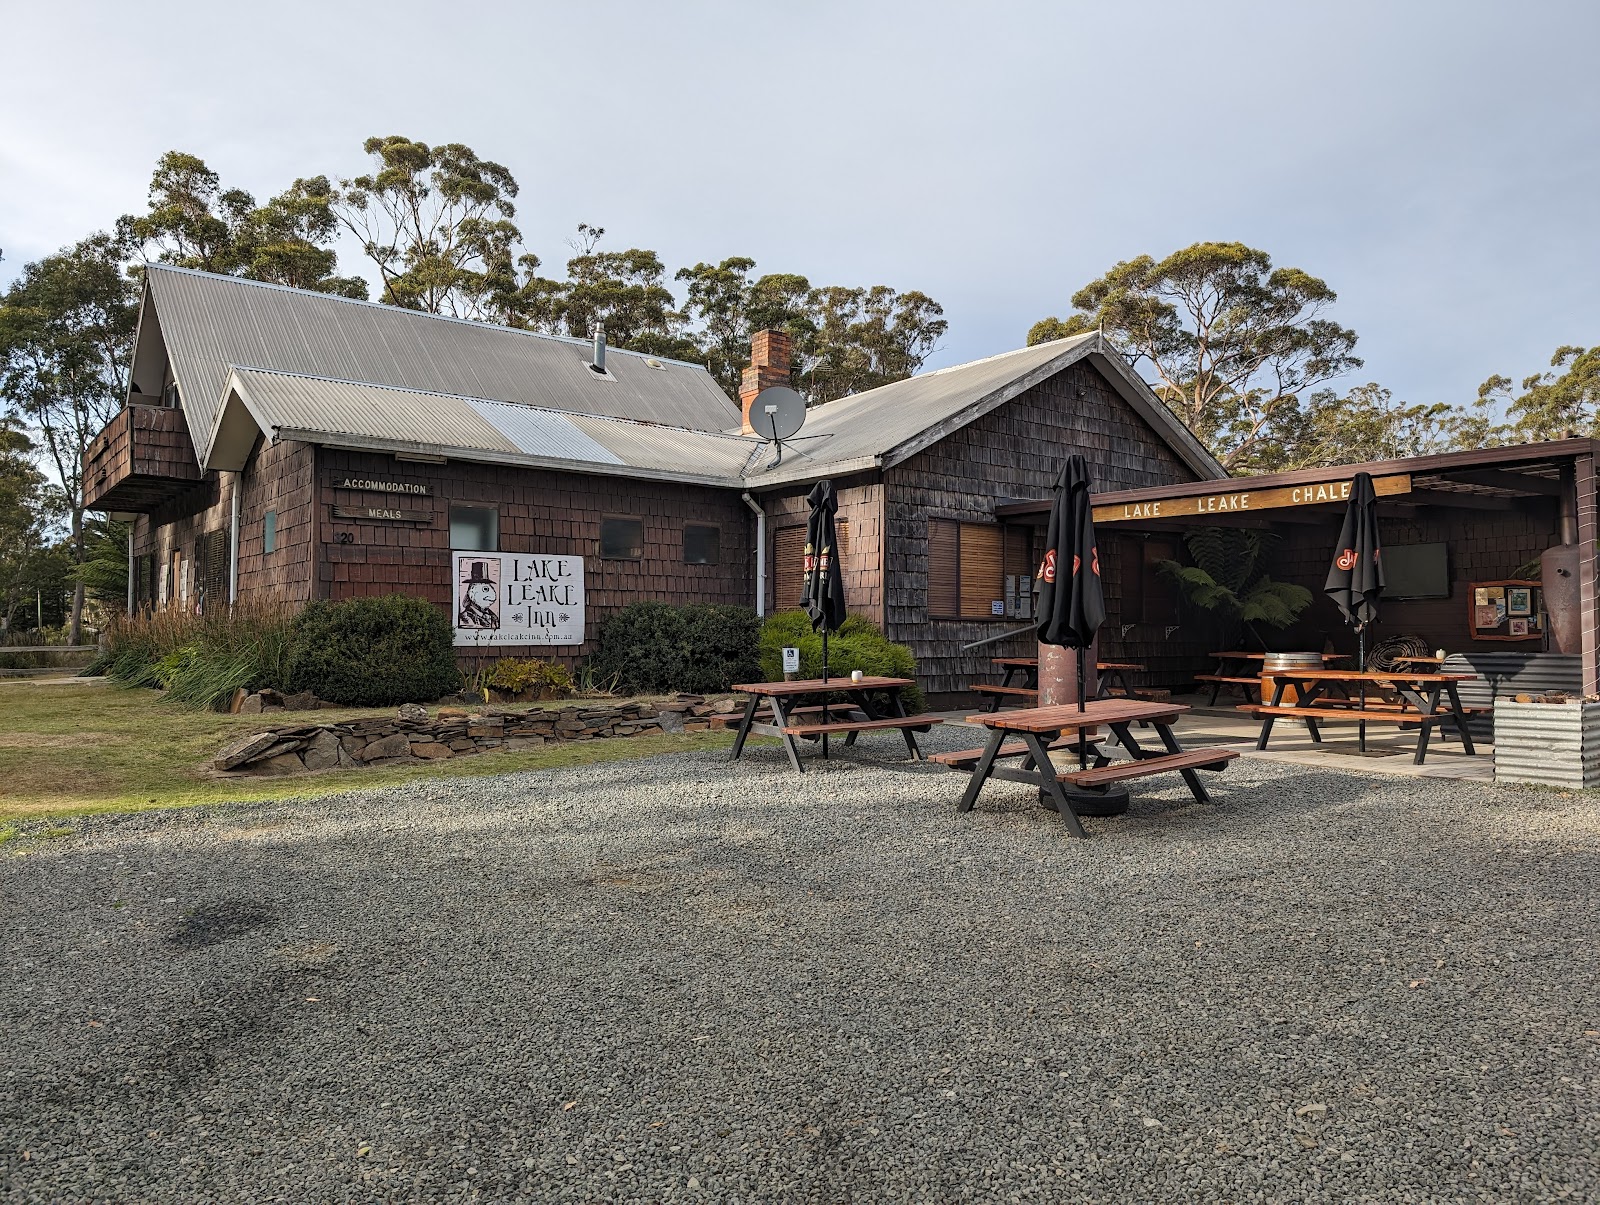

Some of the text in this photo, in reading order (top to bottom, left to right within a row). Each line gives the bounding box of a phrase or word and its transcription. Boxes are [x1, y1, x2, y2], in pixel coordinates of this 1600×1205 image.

[343, 478, 426, 494] ACCOMMODATION
[1124, 482, 1351, 518] LAKE LEAKE CHALE
[368, 508, 402, 519] MEALS
[513, 559, 572, 582] LAKE
[507, 584, 578, 606] LEAKE
[527, 605, 557, 629] Inn
[464, 633, 573, 641] www.akeleakeinn.com.au
